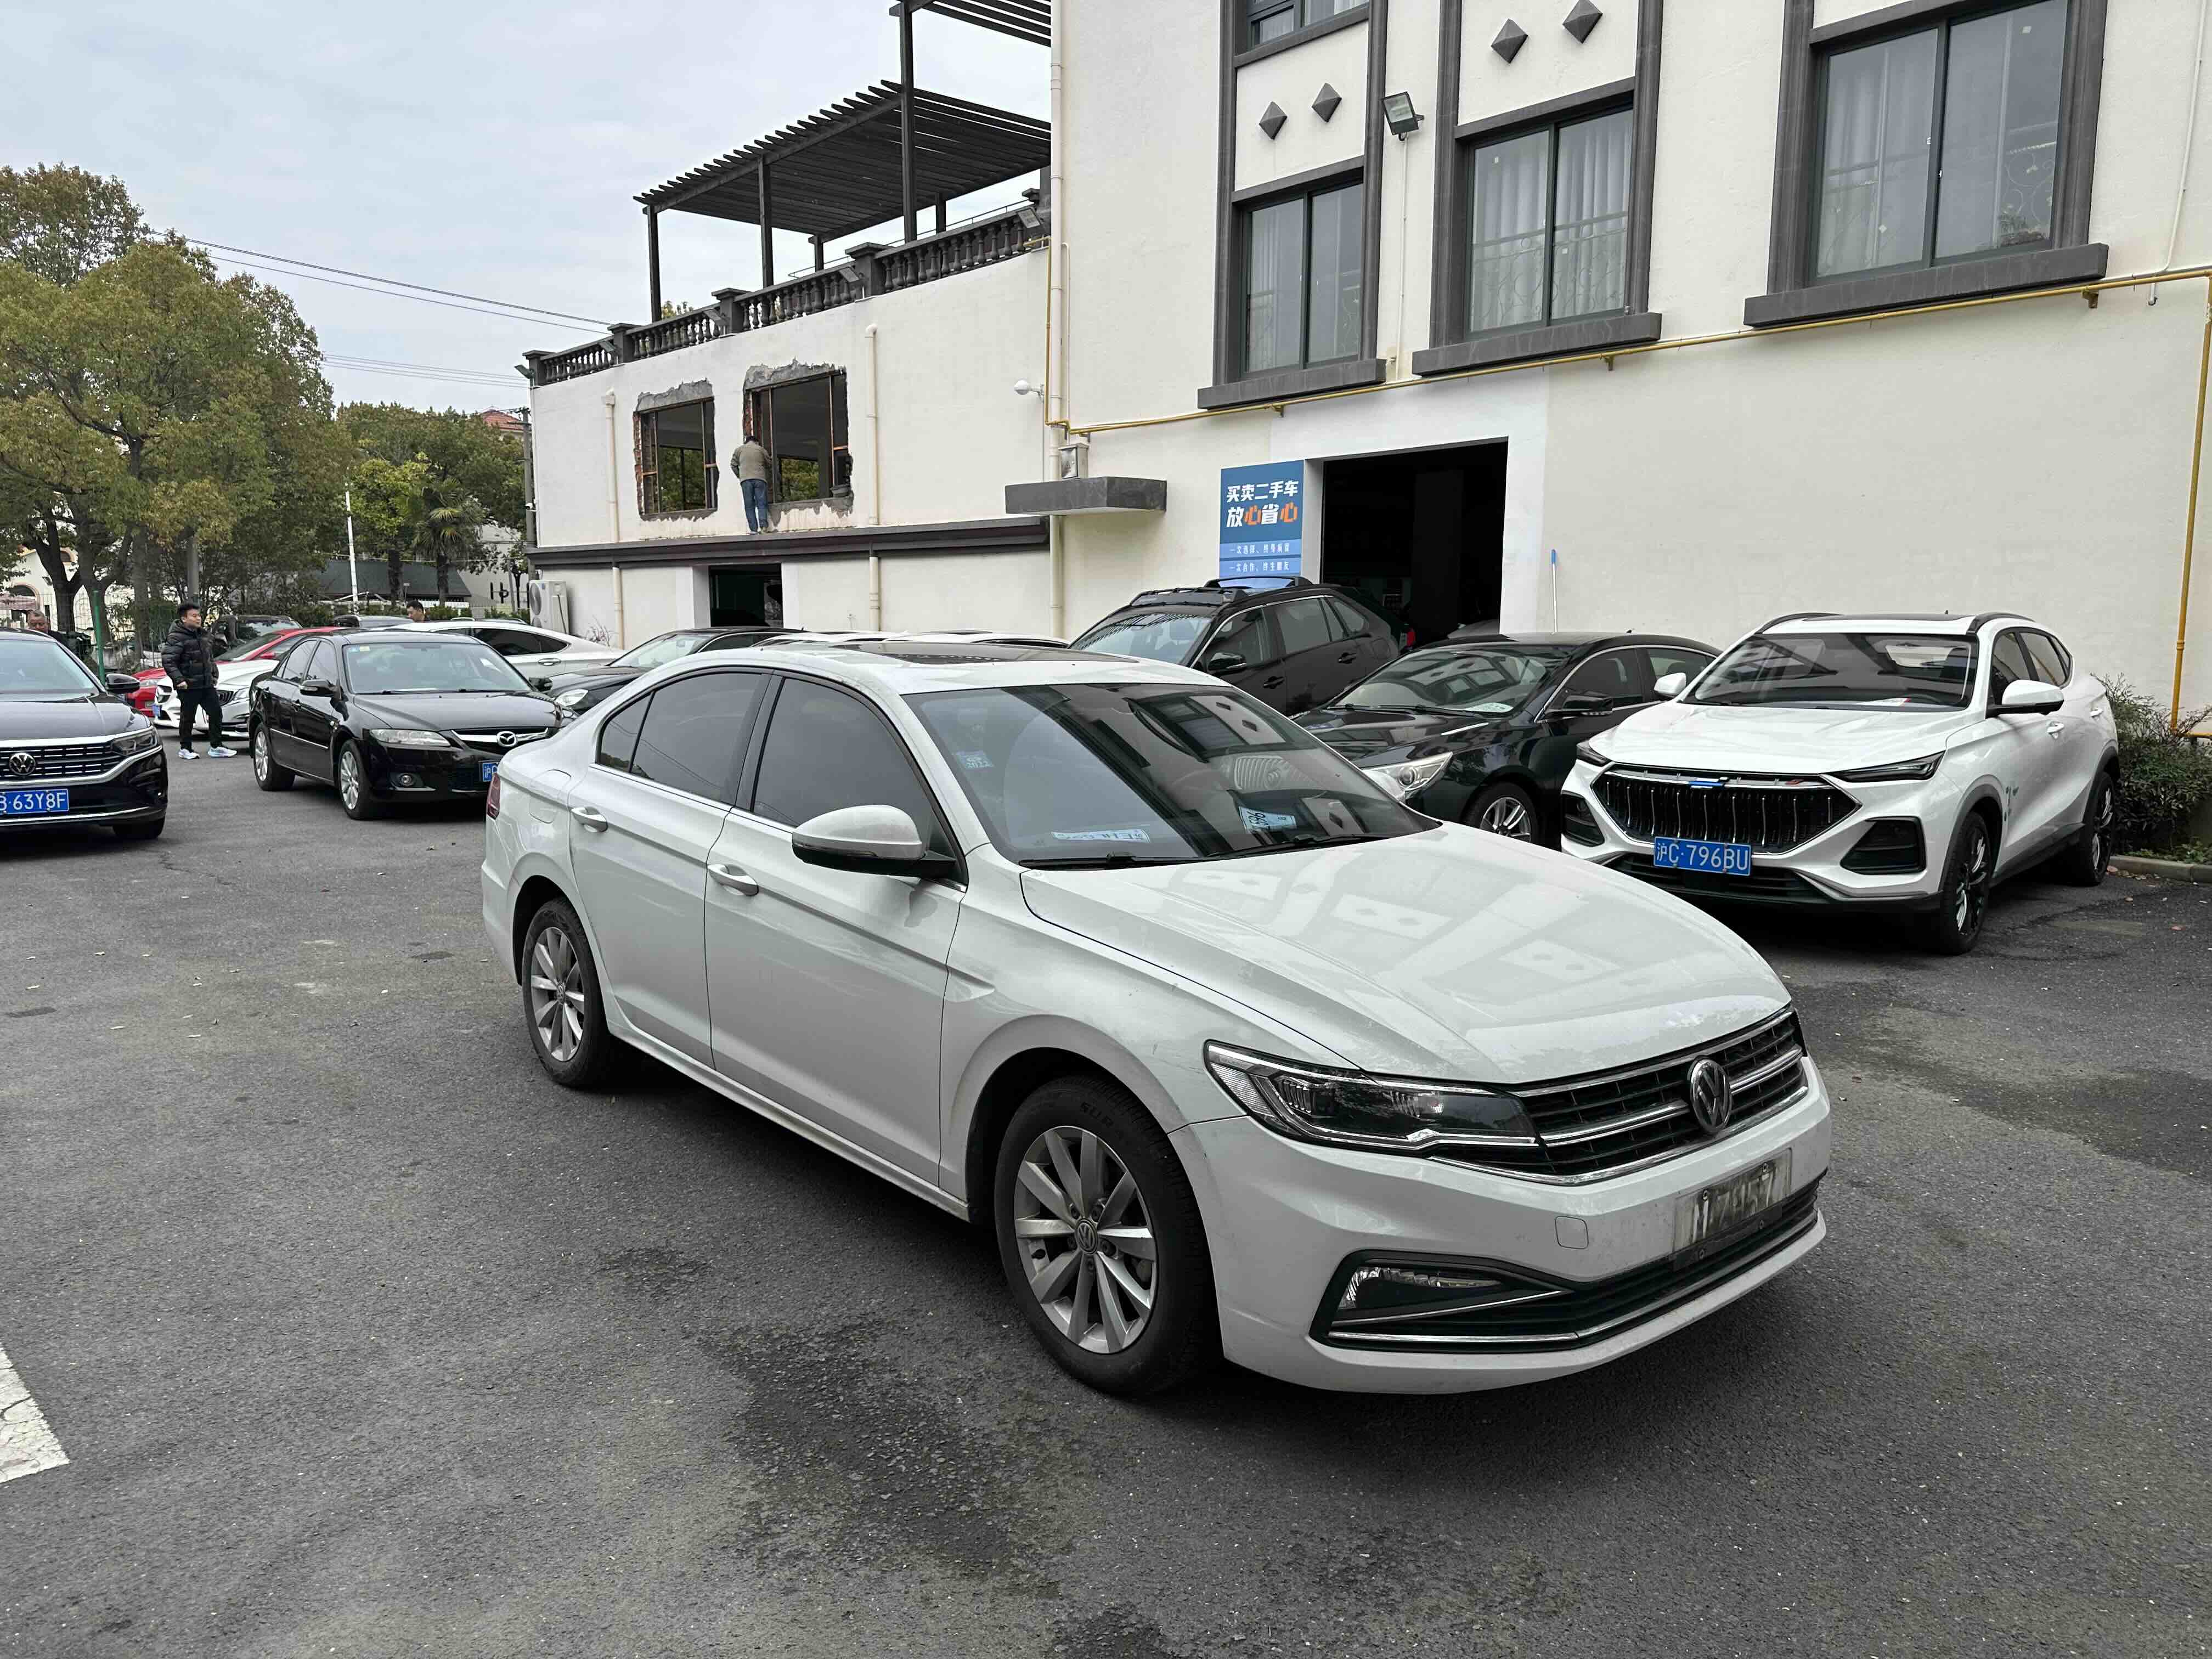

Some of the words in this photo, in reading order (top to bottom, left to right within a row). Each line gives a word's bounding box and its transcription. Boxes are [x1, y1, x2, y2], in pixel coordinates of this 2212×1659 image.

[1227, 480, 1299, 503] 买卖二手车
[1226, 501, 1298, 527] 放心省心
